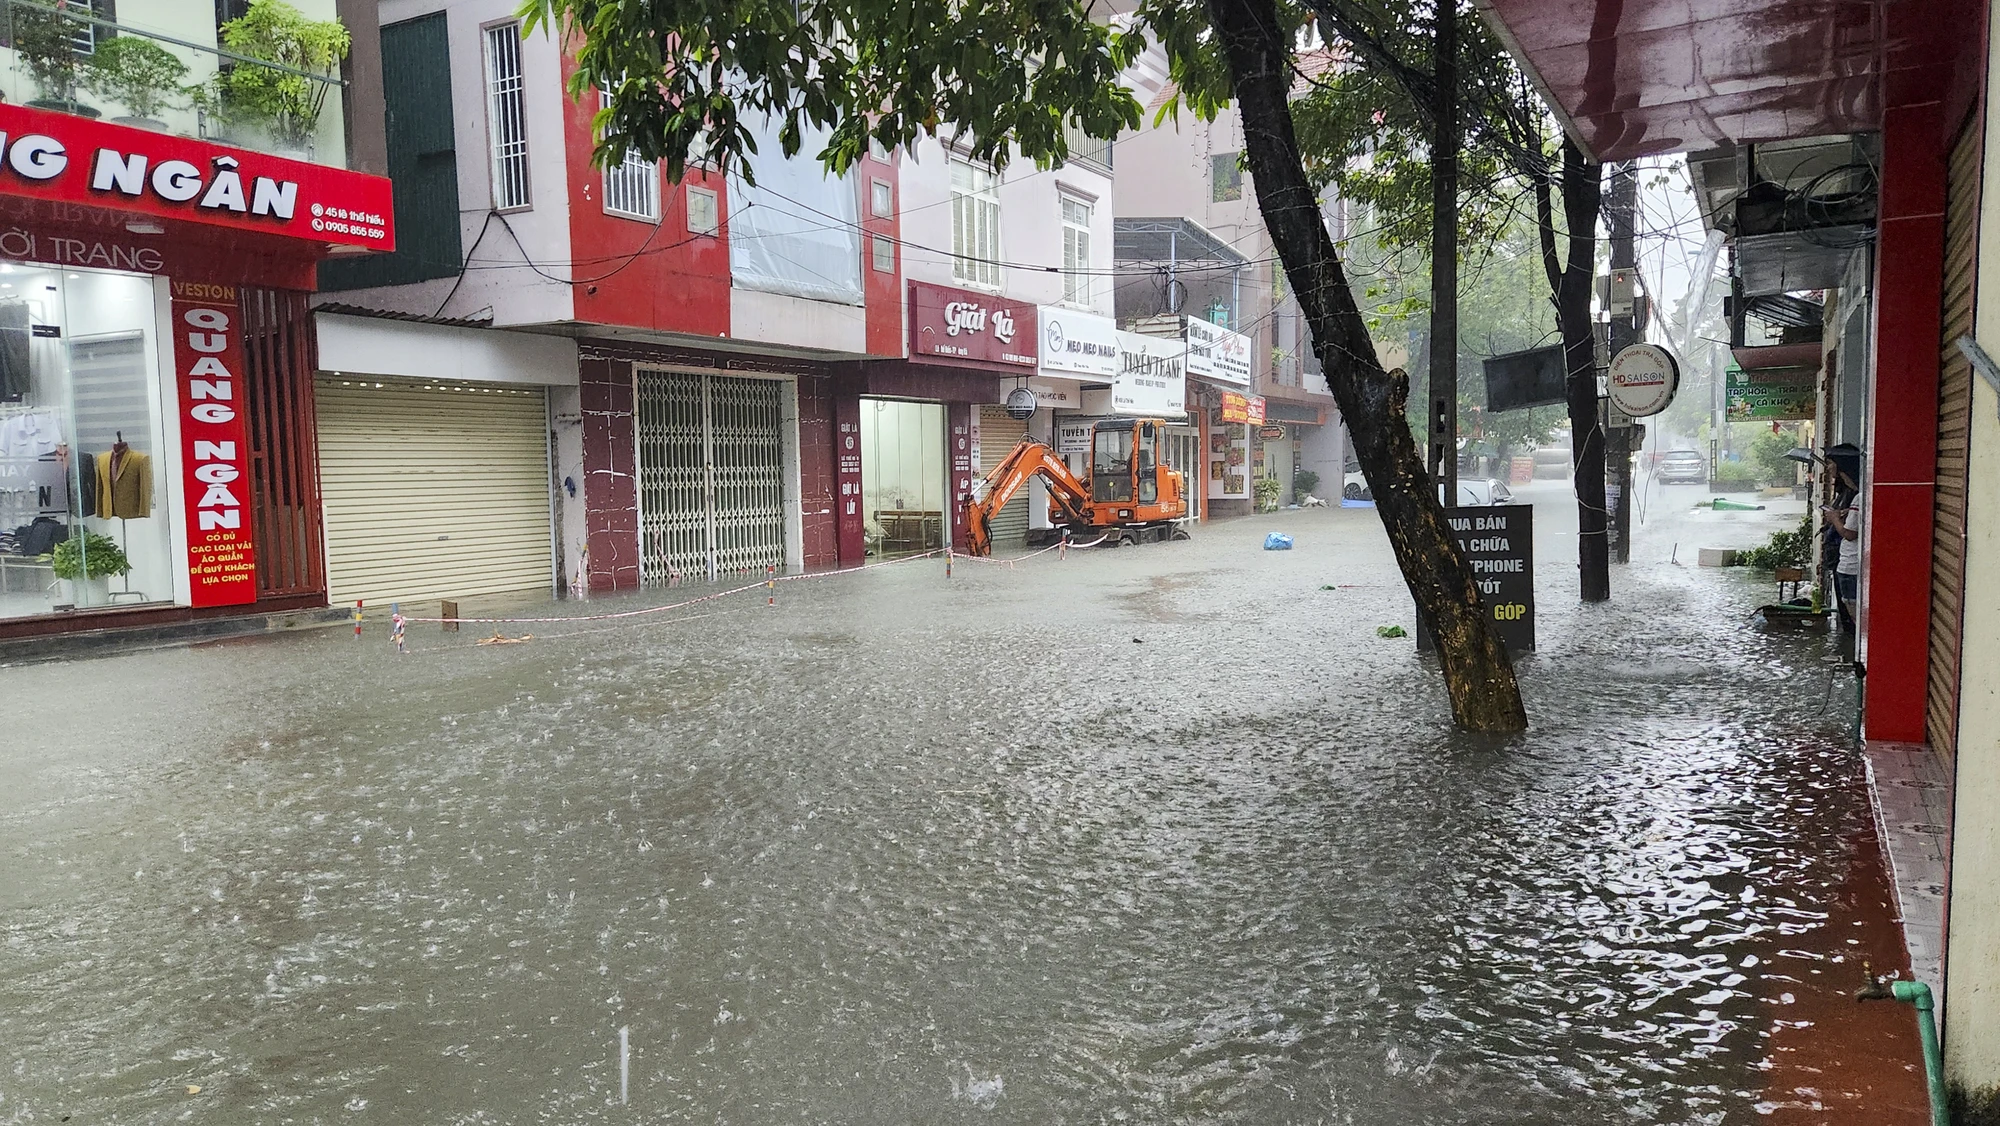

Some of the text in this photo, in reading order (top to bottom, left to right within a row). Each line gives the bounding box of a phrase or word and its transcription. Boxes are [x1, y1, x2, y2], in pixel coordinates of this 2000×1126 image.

[0, 131, 298, 219] G NGÂN
[325, 207, 337, 217] 45
[325, 221, 385, 239] 0905 855 559
[49, 237, 165, 270] TRANG
[173, 281, 235, 300] VESTON
[991, 309, 1016, 344] Là
[184, 308, 235, 424] QUANG
[1612, 374, 1626, 384] HD
[1627, 372, 1665, 383] SAISON
[194, 441, 241, 530] NGÂN
[1475, 515, 1506, 530] BÁN
[206, 531, 220, 541] CÓ
[1470, 535, 1510, 552] CHỮA
[221, 573, 248, 583] CHỌN
[1494, 601, 1526, 620] GÓP
